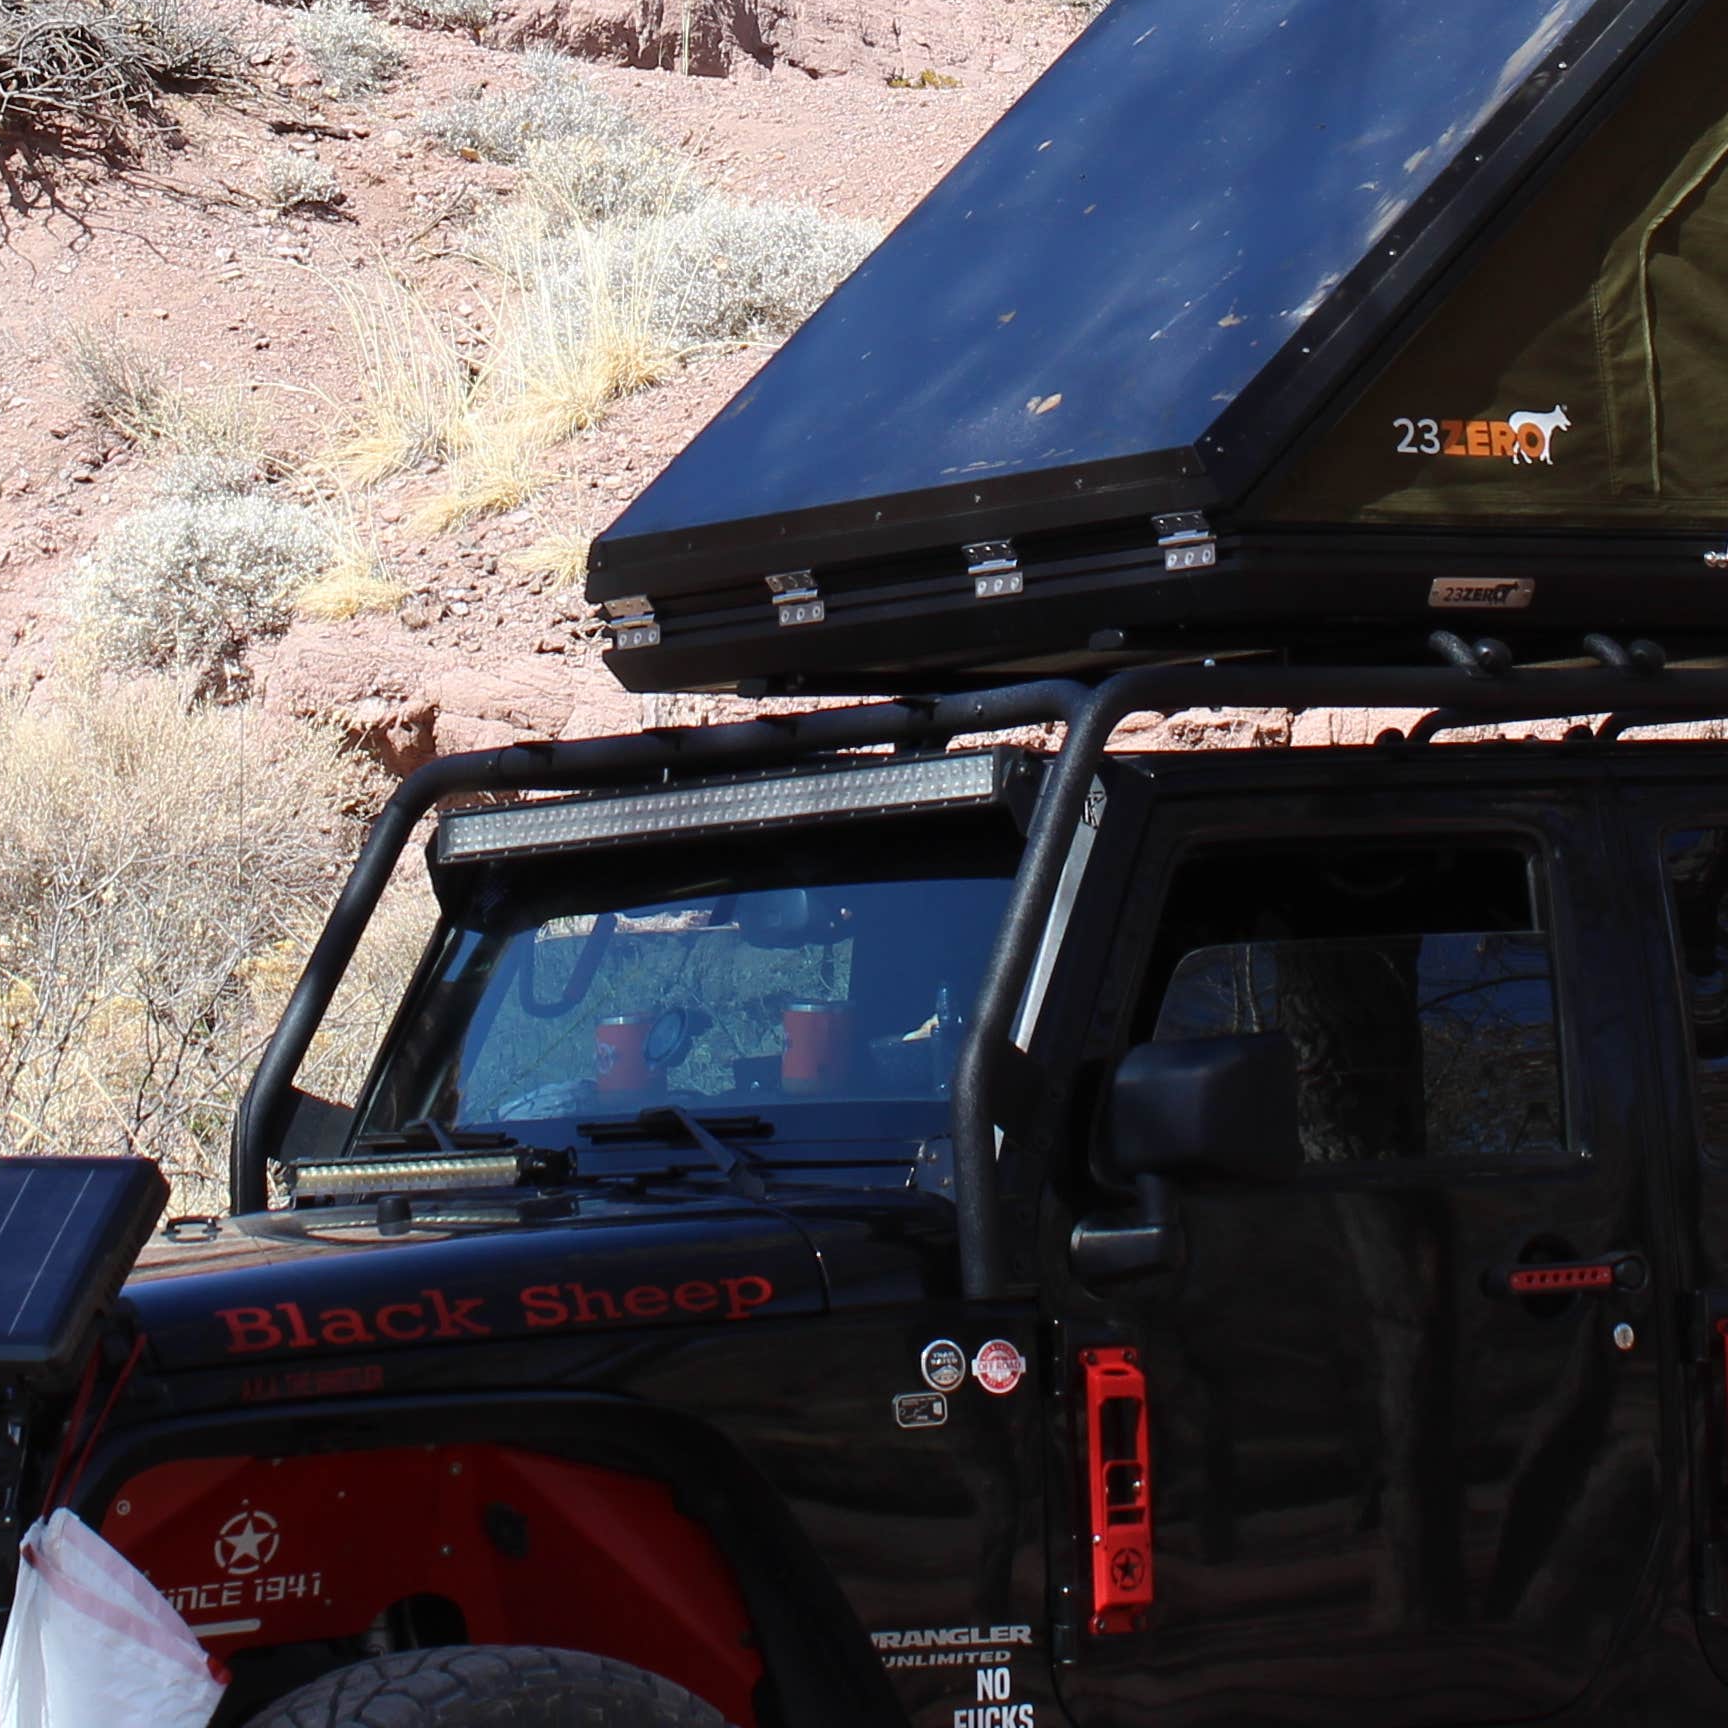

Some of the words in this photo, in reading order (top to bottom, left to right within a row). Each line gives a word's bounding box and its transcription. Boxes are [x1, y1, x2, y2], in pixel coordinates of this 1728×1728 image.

[1392, 418, 1547, 458] 23ZERO
[1443, 584, 1512, 603] 23ZERO
[213, 1289, 492, 1354] Black
[519, 1275, 774, 1329] Sheep
[160, 1581, 244, 1611] INCE
[254, 1572, 322, 1602] 1941
[881, 1650, 1012, 1668] UNLIMITED
[976, 1666, 1011, 1702] NO
[954, 1703, 1035, 1728] FUCKS
